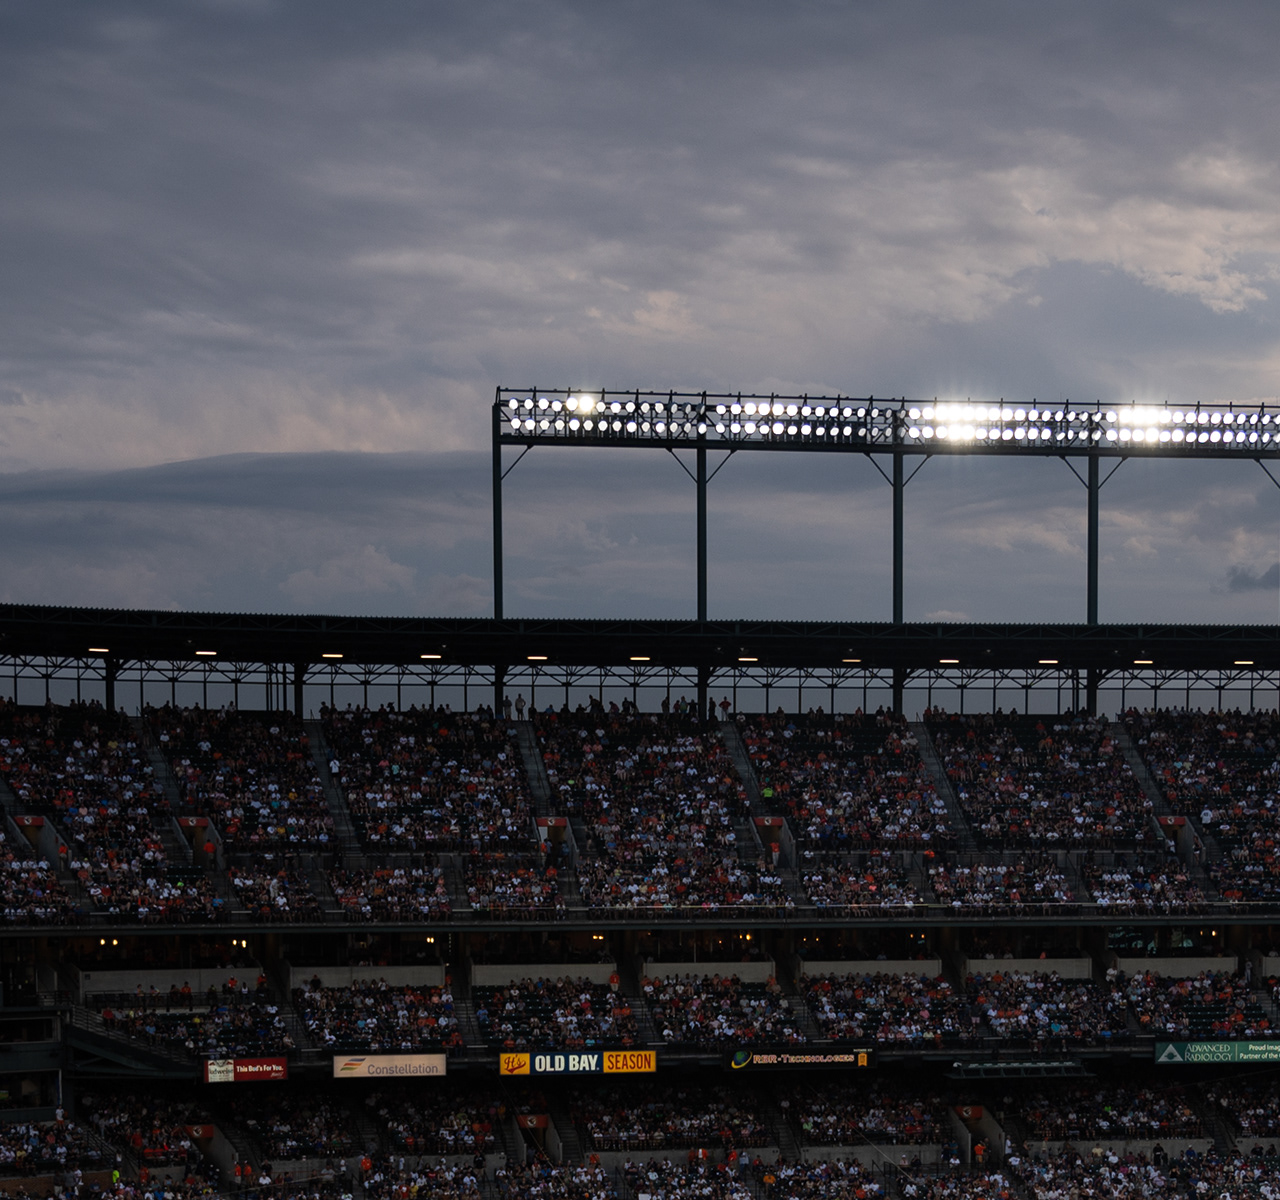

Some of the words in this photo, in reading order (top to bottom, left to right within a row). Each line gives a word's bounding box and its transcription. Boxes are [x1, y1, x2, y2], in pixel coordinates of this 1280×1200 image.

[1186, 1043, 1231, 1052] ADVANCED
[1184, 1052, 1233, 1062] RADIOLOGY
[1239, 1052, 1263, 1060] Partner
[504, 1054, 526, 1073] It's
[534, 1055, 566, 1072] OLD
[607, 1053, 652, 1070] SEASON
[236, 1065, 247, 1073] This
[263, 1064, 272, 1072] For
[367, 1063, 438, 1076] Constellation
